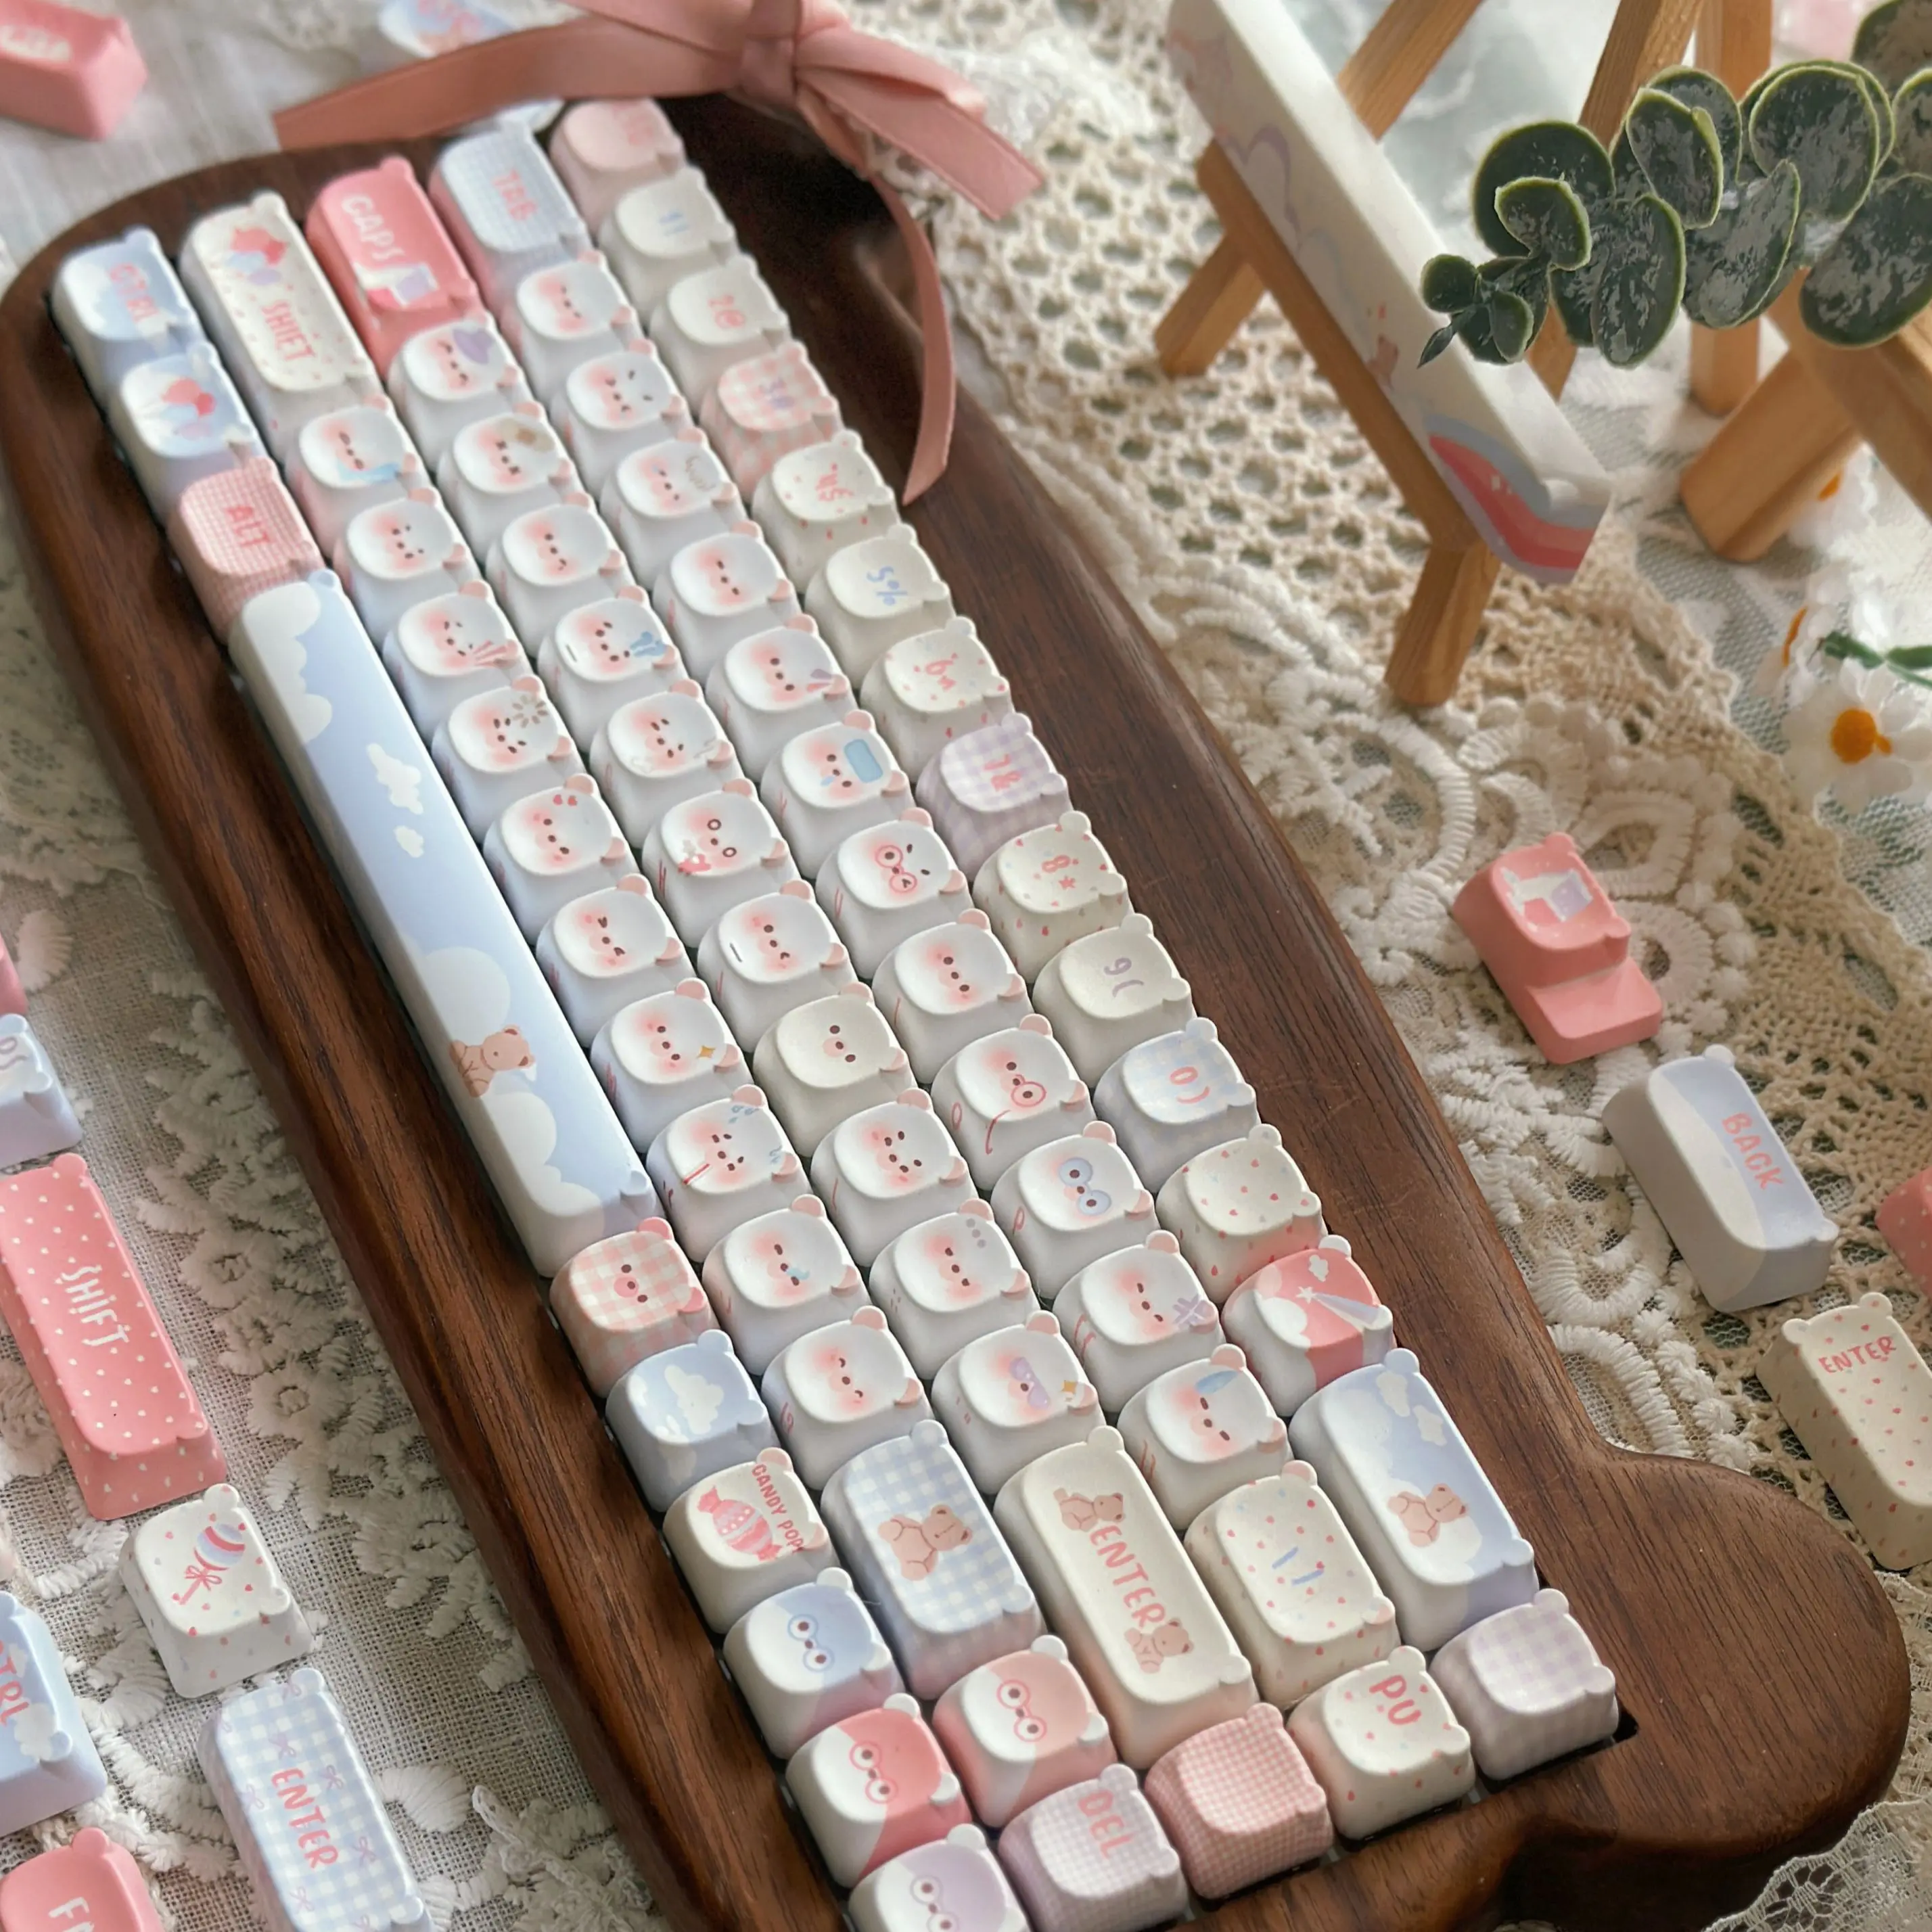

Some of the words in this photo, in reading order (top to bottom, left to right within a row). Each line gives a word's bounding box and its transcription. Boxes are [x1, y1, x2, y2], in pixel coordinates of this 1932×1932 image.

[342, 196, 405, 261] CAPS
[261, 301, 316, 363] SHIFT
[227, 505, 272, 547] ALT
[1722, 1113, 1784, 1189] BACK
[61, 1264, 129, 1346] SHIFT
[1818, 1336, 1896, 1373] ENTER
[752, 1464, 787, 1514] CANDY
[1090, 1525, 1165, 1628] ENTER
[1369, 1675, 1422, 1724] PU
[272, 1768, 338, 1868] ENTER
[1078, 1789, 1135, 1860] DEL
